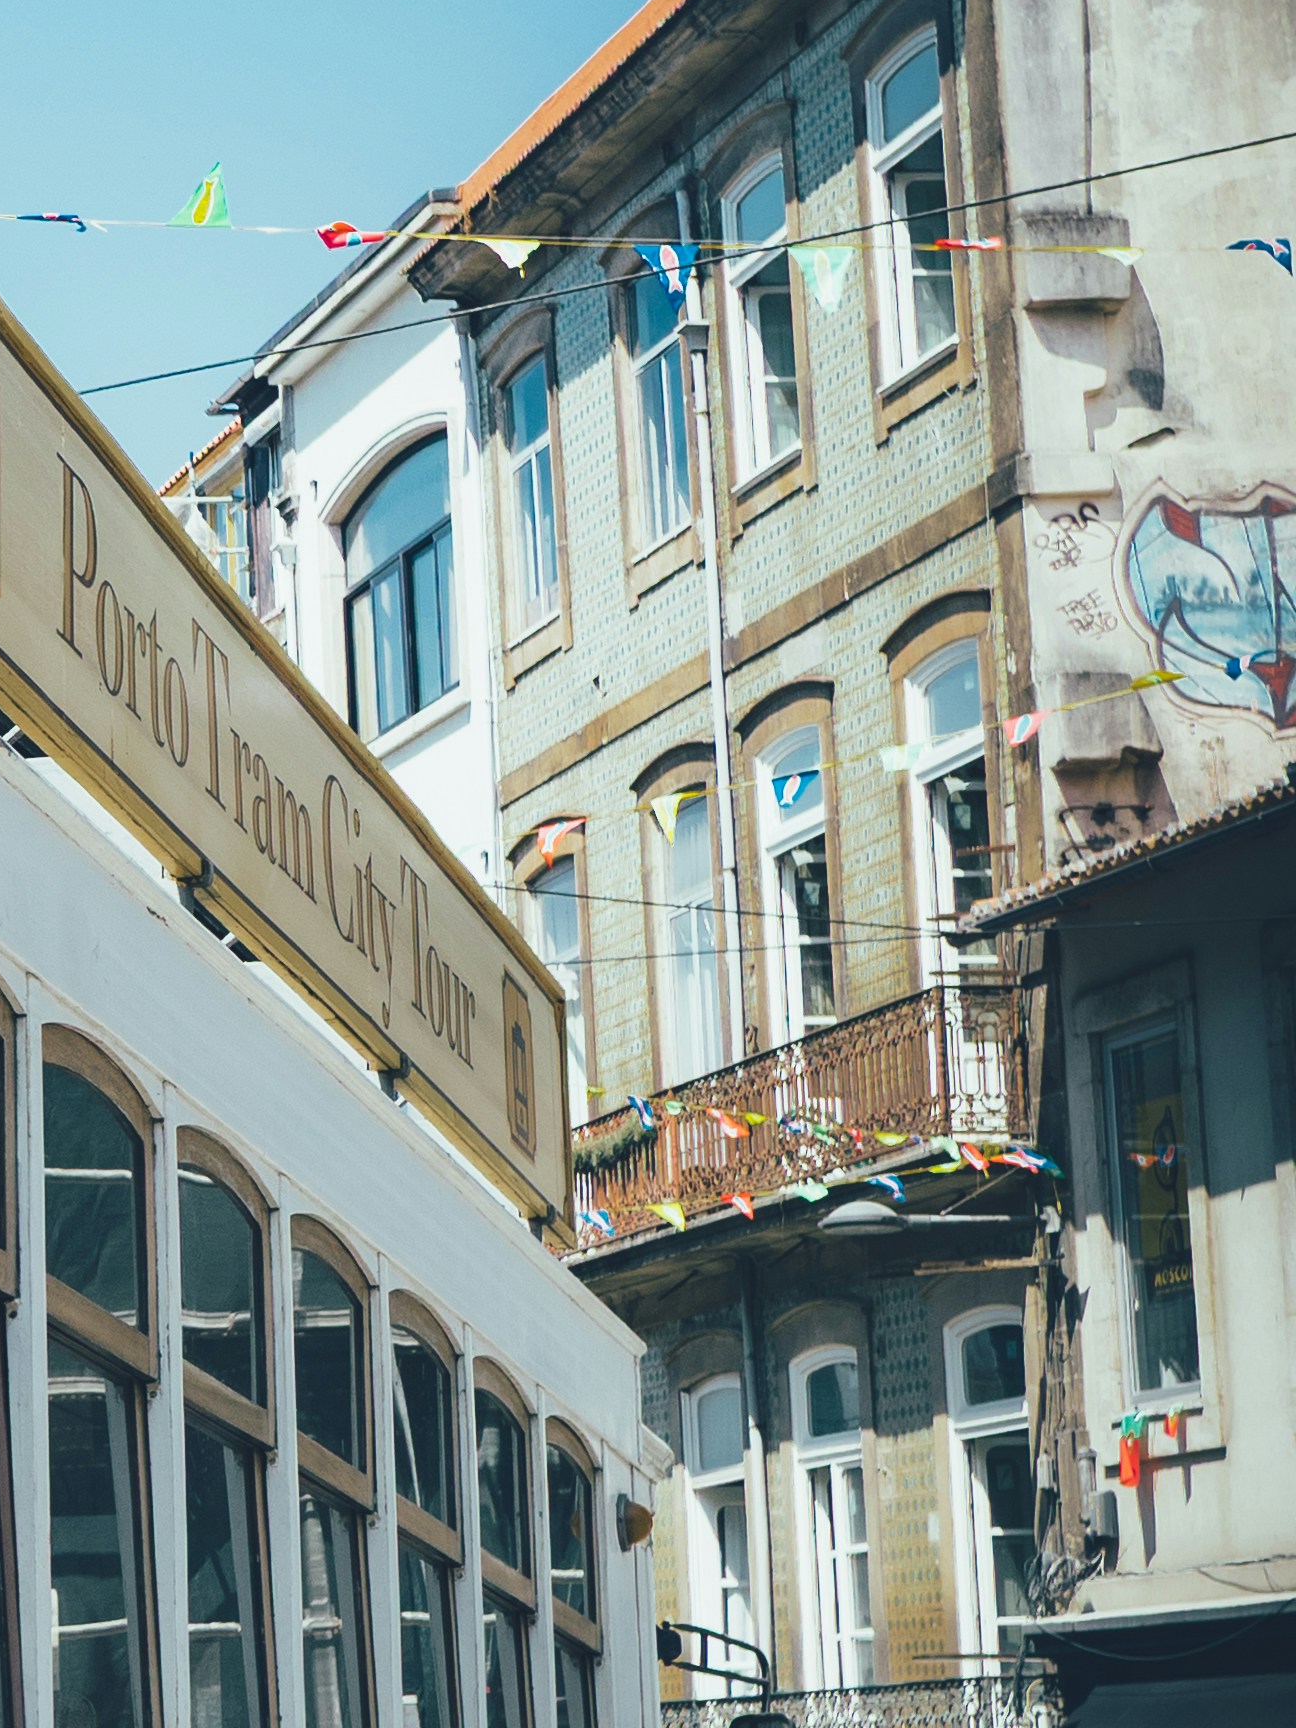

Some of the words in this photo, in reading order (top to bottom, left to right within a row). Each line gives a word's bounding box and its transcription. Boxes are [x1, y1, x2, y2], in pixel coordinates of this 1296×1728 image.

[56, 451, 190, 768] Porto
[192, 617, 317, 904] Tram
[322, 774, 397, 1030] City
[400, 854, 476, 1071] Tour
